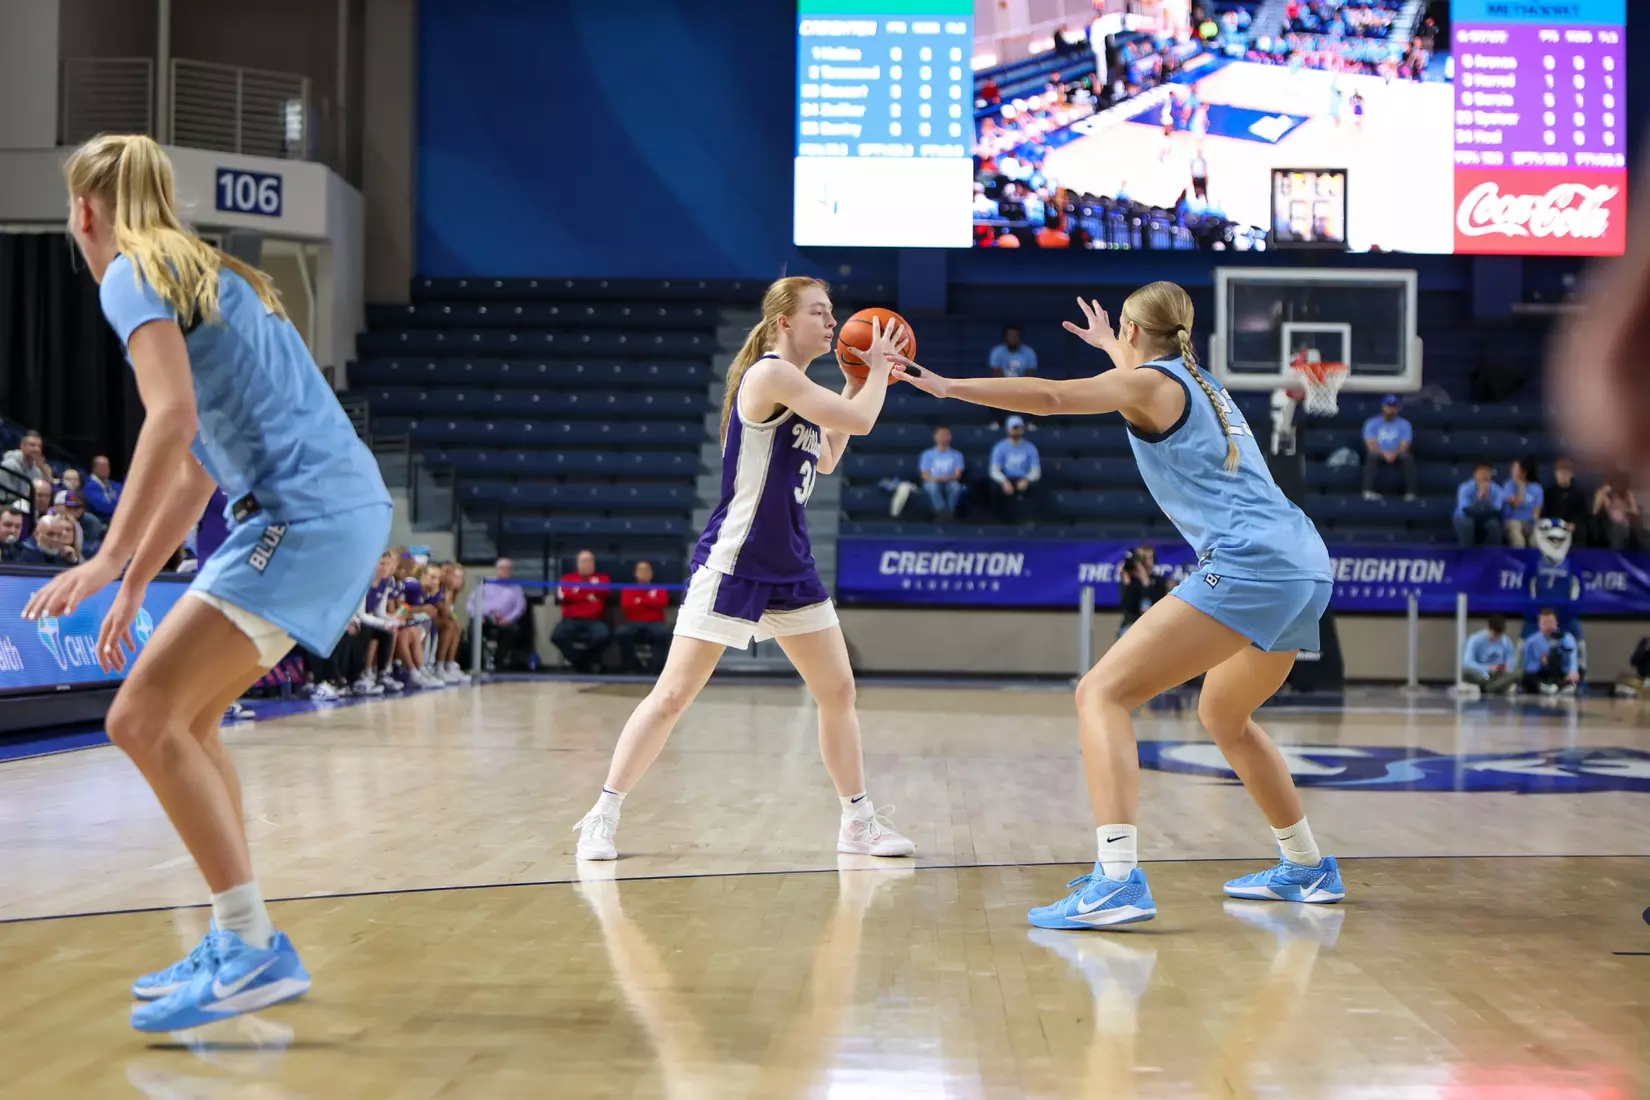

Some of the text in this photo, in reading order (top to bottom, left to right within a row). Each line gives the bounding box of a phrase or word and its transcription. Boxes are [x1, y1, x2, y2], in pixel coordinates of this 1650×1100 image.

[220, 173, 279, 213] 106
[794, 460, 816, 507] 3
[879, 551, 1025, 577] CREIGHTON
[1079, 563, 1114, 583] THE
[1501, 570, 1523, 590] TH
